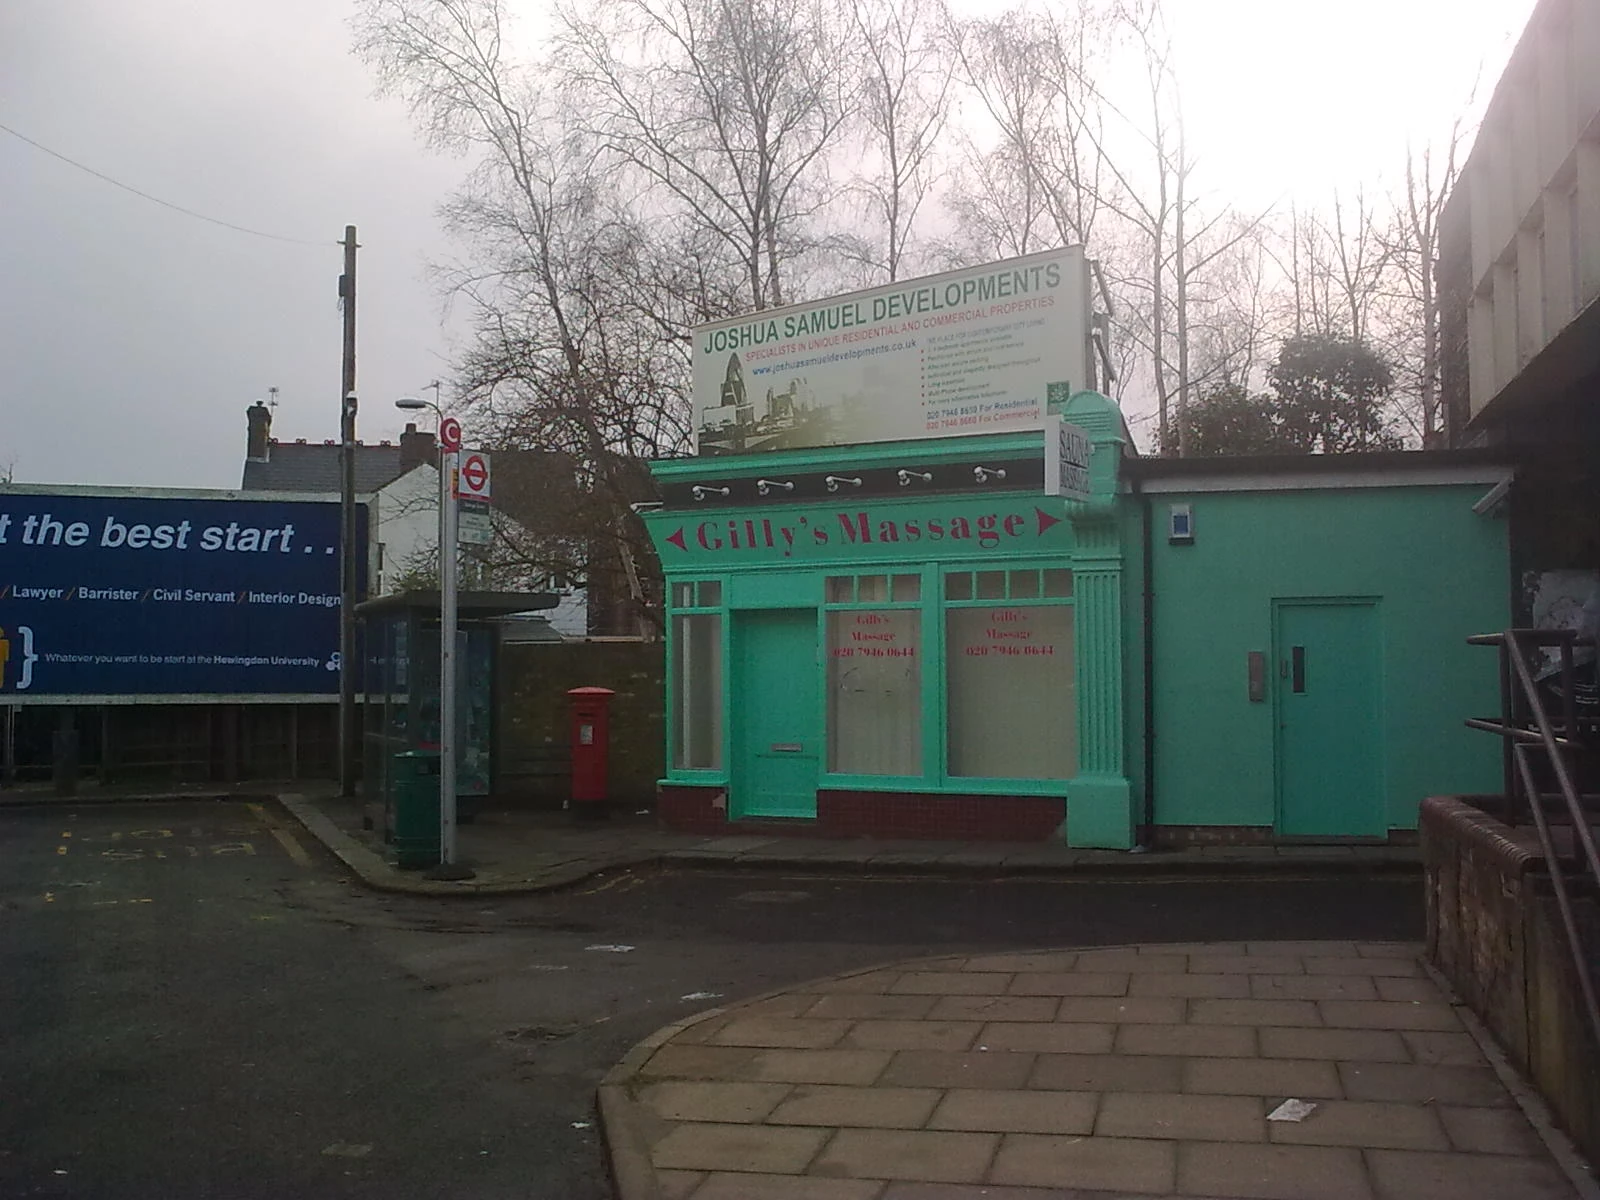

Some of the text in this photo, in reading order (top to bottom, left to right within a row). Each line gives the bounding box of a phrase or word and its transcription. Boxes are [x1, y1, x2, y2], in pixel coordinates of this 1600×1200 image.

[704, 263, 1061, 354] JOSHUA SAMUEL DEVELOPMENTS
[745, 296, 1055, 362] SPECIALISTS IN UNIQUE RESIDENTIAL AND COMMERCIAL PROPERTIES
[753, 339, 918, 376] www.joshuasamueldevelopments.co.uk
[22, 513, 90, 547] the
[101, 516, 191, 549] best
[200, 523, 295, 554] start
[697, 508, 1026, 557] Gilly's Massage
[12, 585, 64, 600] Lawyer
[78, 586, 139, 600] Barrister
[153, 588, 182, 601] Civil
[184, 589, 236, 603] Servant
[248, 590, 296, 604] Interior
[850, 631, 896, 643] Massage
[985, 628, 1032, 640] Massage
[832, 647, 854, 658] 020
[966, 645, 989, 656] 020
[45, 653, 94, 664] Whatever
[95, 655, 113, 666] you
[114, 655, 138, 664] want
[139, 654, 149, 664] to
[151, 655, 162, 664] be
[164, 655, 185, 665] start
[186, 655, 196, 665] at
[197, 655, 213, 665] the
[271, 656, 320, 668] University
